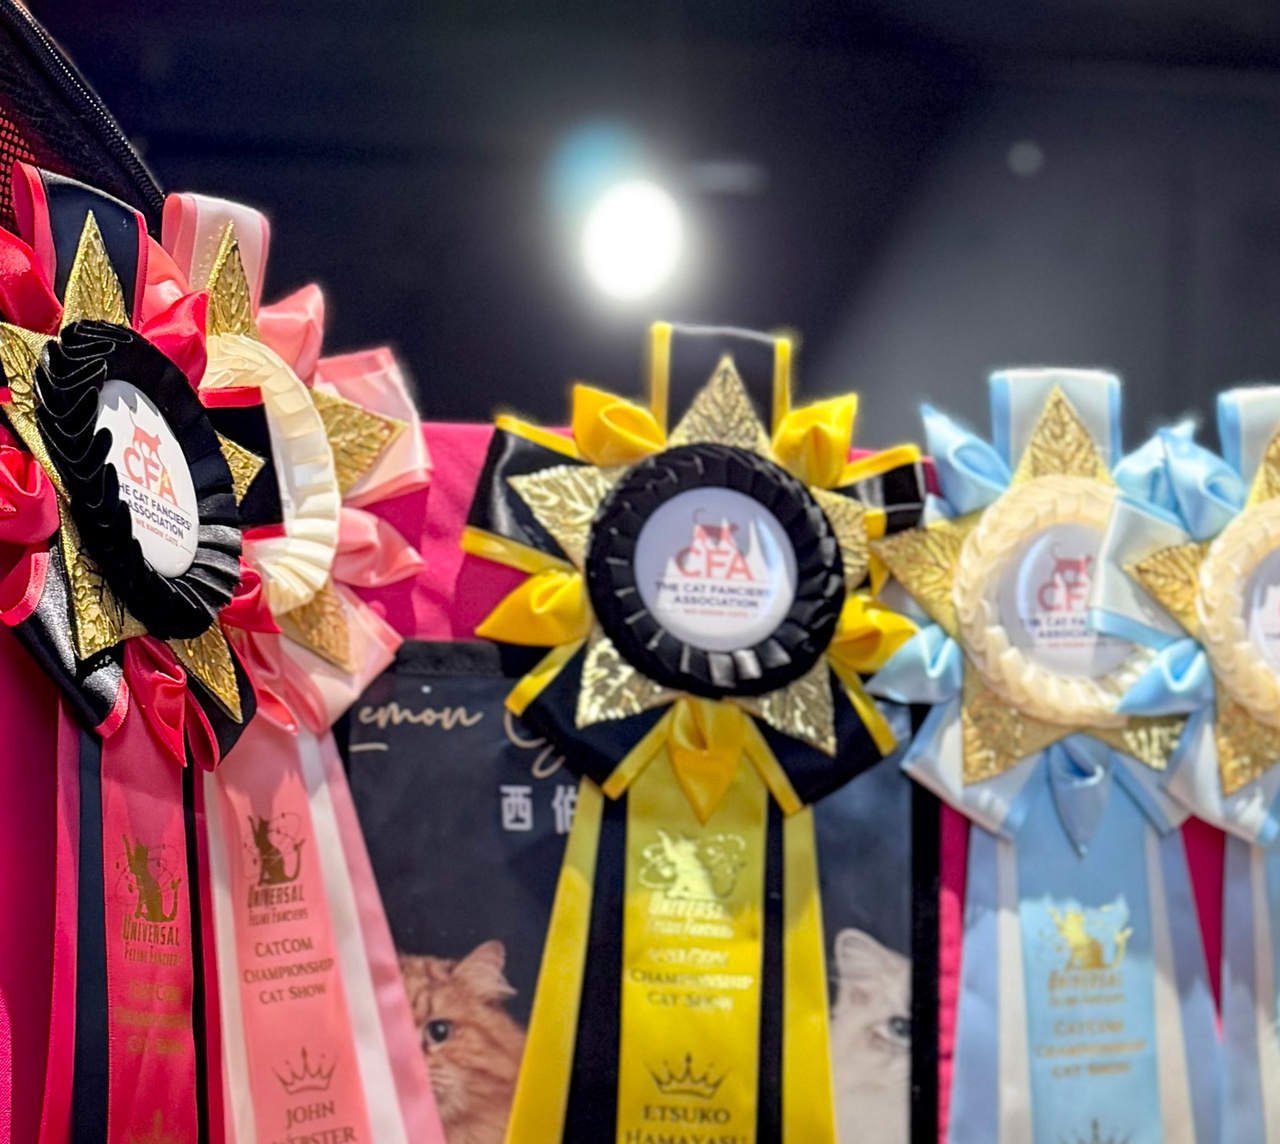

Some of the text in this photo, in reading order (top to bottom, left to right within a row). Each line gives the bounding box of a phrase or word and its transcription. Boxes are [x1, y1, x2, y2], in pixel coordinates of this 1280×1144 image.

[124, 446, 178, 507] CFA
[132, 489, 149, 504] CAT
[675, 547, 755, 580] CFA
[1037, 581, 1090, 612] CF
[247, 885, 305, 909] UNIVERSAL
[123, 913, 180, 947] UNIVERSAL
[243, 958, 334, 984] CHAMPIONSHIP
[259, 982, 327, 1004] CAT SHOW
[286, 1101, 335, 1130] JOHN
[643, 1104, 731, 1124] ETSUKO
